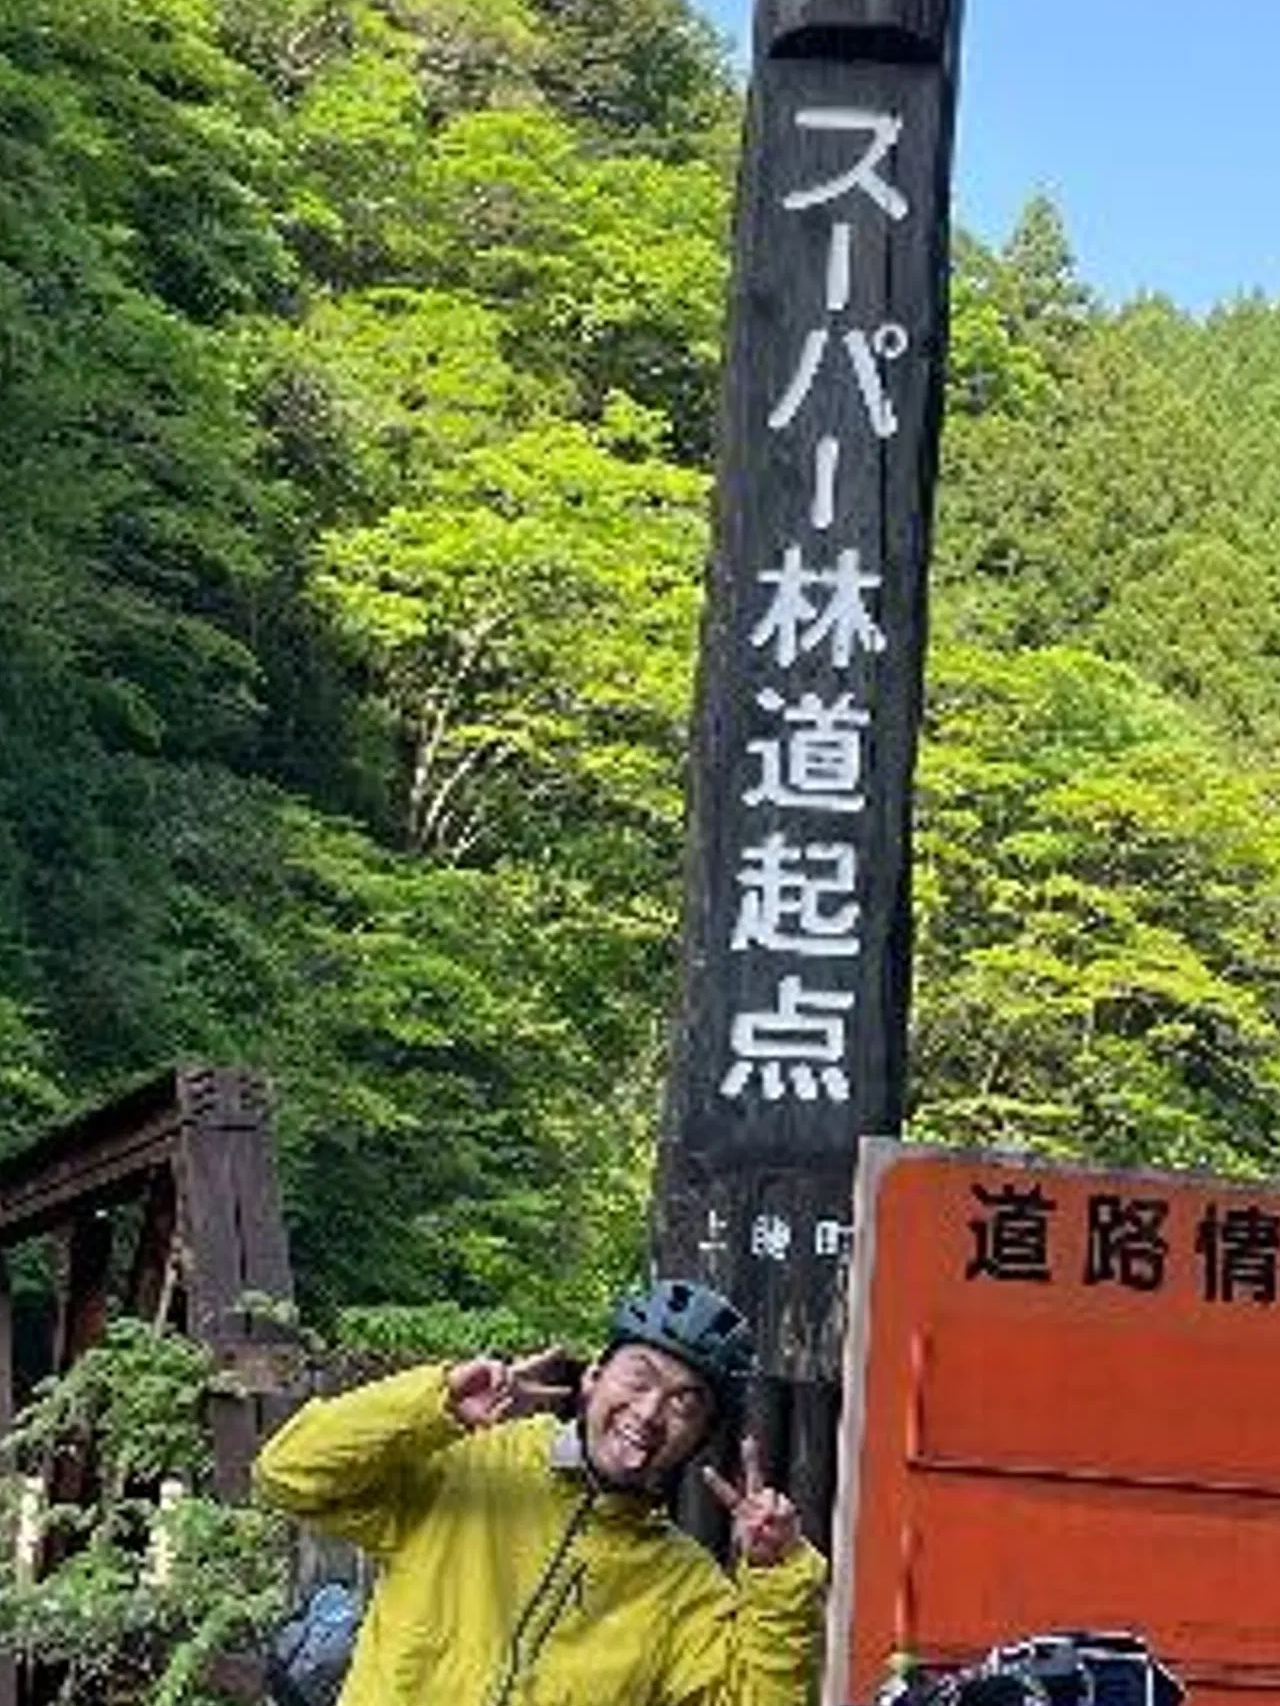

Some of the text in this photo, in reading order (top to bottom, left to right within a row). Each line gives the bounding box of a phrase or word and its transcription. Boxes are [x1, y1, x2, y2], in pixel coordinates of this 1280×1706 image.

[720, 109, 908, 1101] スーパー林道起点
